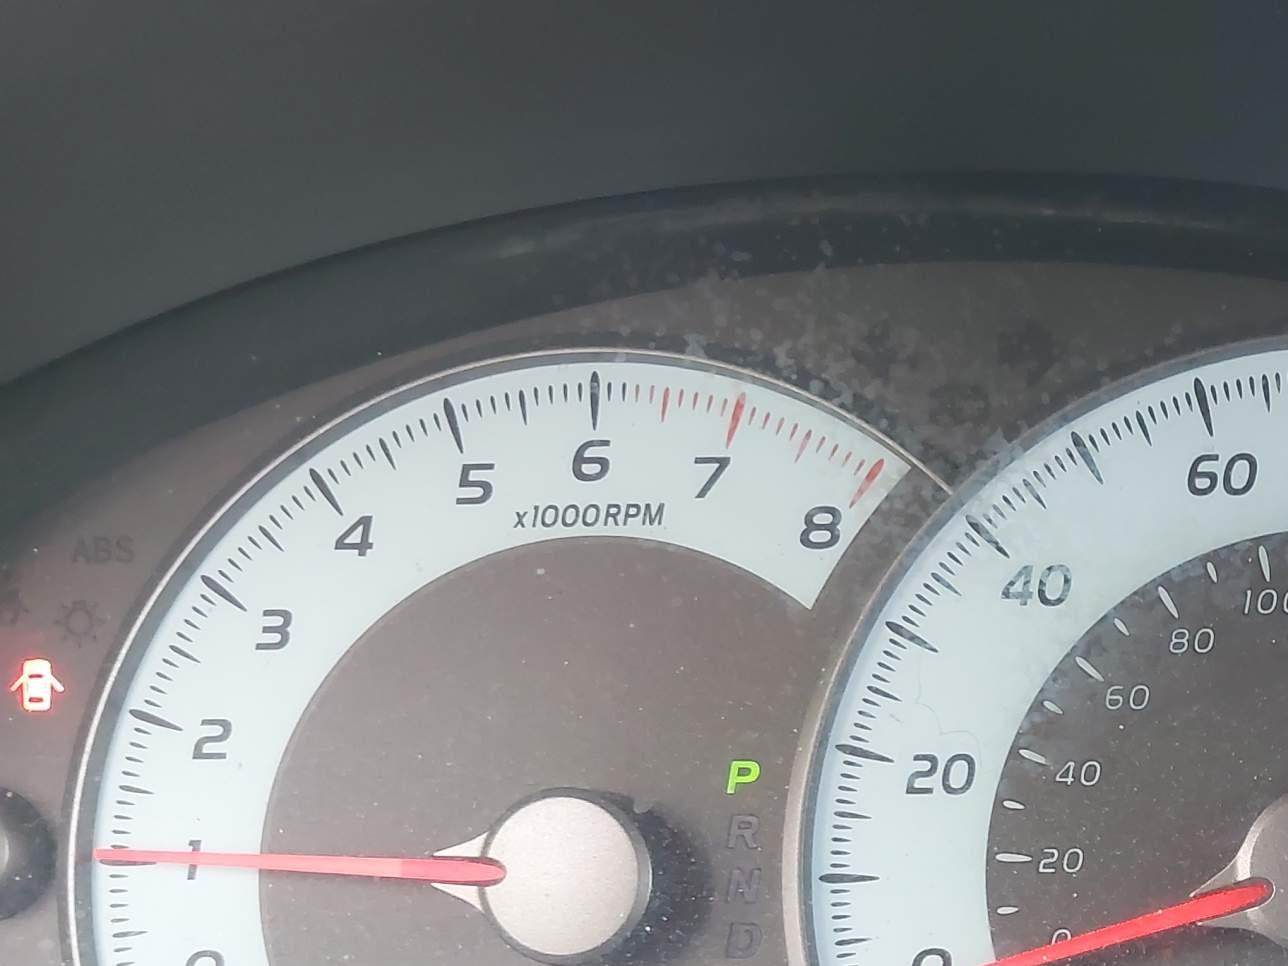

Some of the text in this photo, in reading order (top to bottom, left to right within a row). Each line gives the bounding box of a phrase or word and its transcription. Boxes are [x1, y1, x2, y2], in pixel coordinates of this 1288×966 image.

[572, 439, 611, 482] 6
[694, 456, 731, 499] 7
[1187, 453, 1257, 496] 60
[456, 463, 495, 505] 5
[334, 515, 374, 556] 4
[799, 505, 842, 550] 8
[72, 535, 135, 564] ABS
[1001, 565, 1072, 607] 40
[255, 609, 292, 651] 3
[1169, 628, 1215, 653] 80
[1105, 685, 1150, 710] 60
[191, 718, 232, 760] 2
[726, 760, 761, 795] P
[905, 753, 976, 795] 20
[1055, 761, 1101, 786] 40
[727, 814, 760, 849] R
[187, 840, 202, 880] 1
[1038, 848, 1083, 873] 20
[726, 867, 762, 904] N
[725, 921, 763, 959] D
